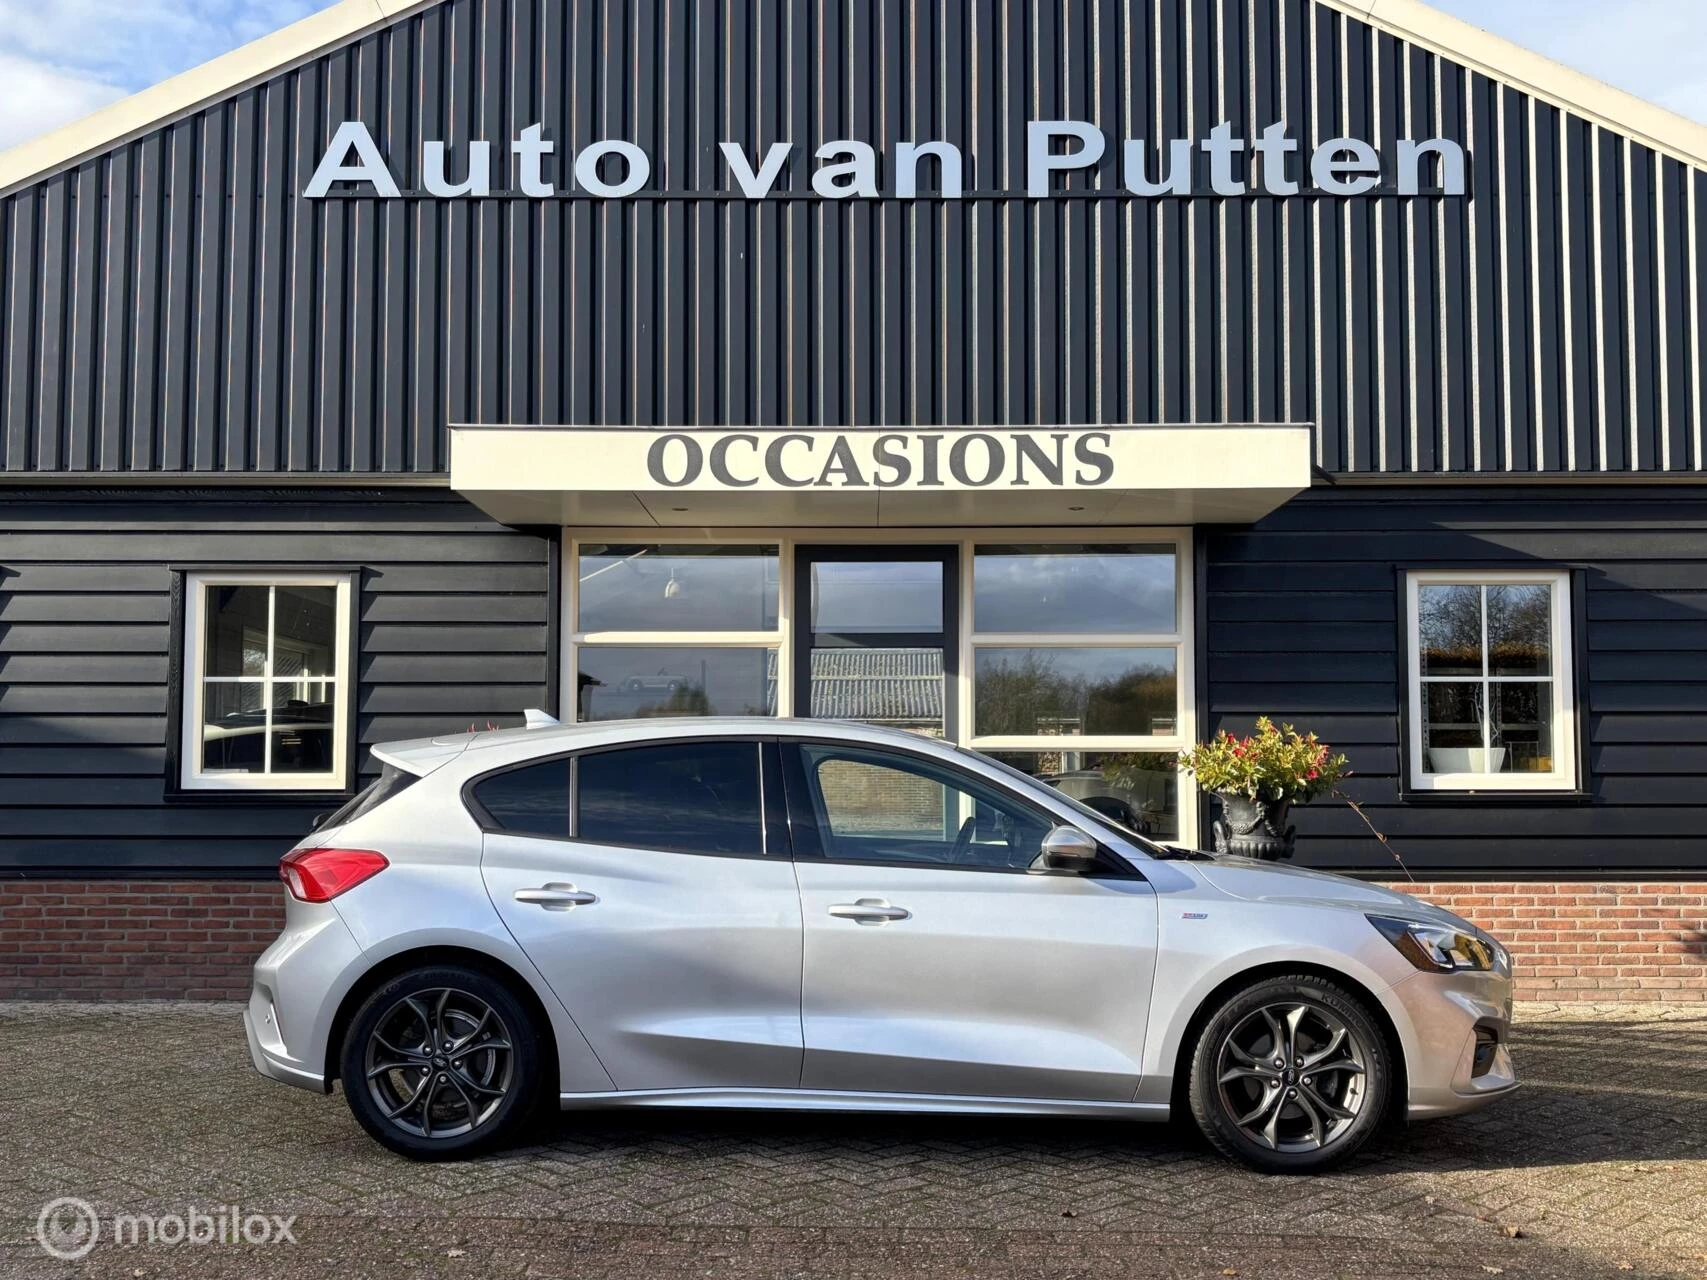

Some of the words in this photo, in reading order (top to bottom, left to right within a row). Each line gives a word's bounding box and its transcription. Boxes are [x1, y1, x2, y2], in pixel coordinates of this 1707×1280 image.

[302, 121, 650, 198] Auto
[718, 139, 963, 199] van
[1027, 119, 1465, 198] Putten
[646, 432, 1115, 488] OCCASIONS
